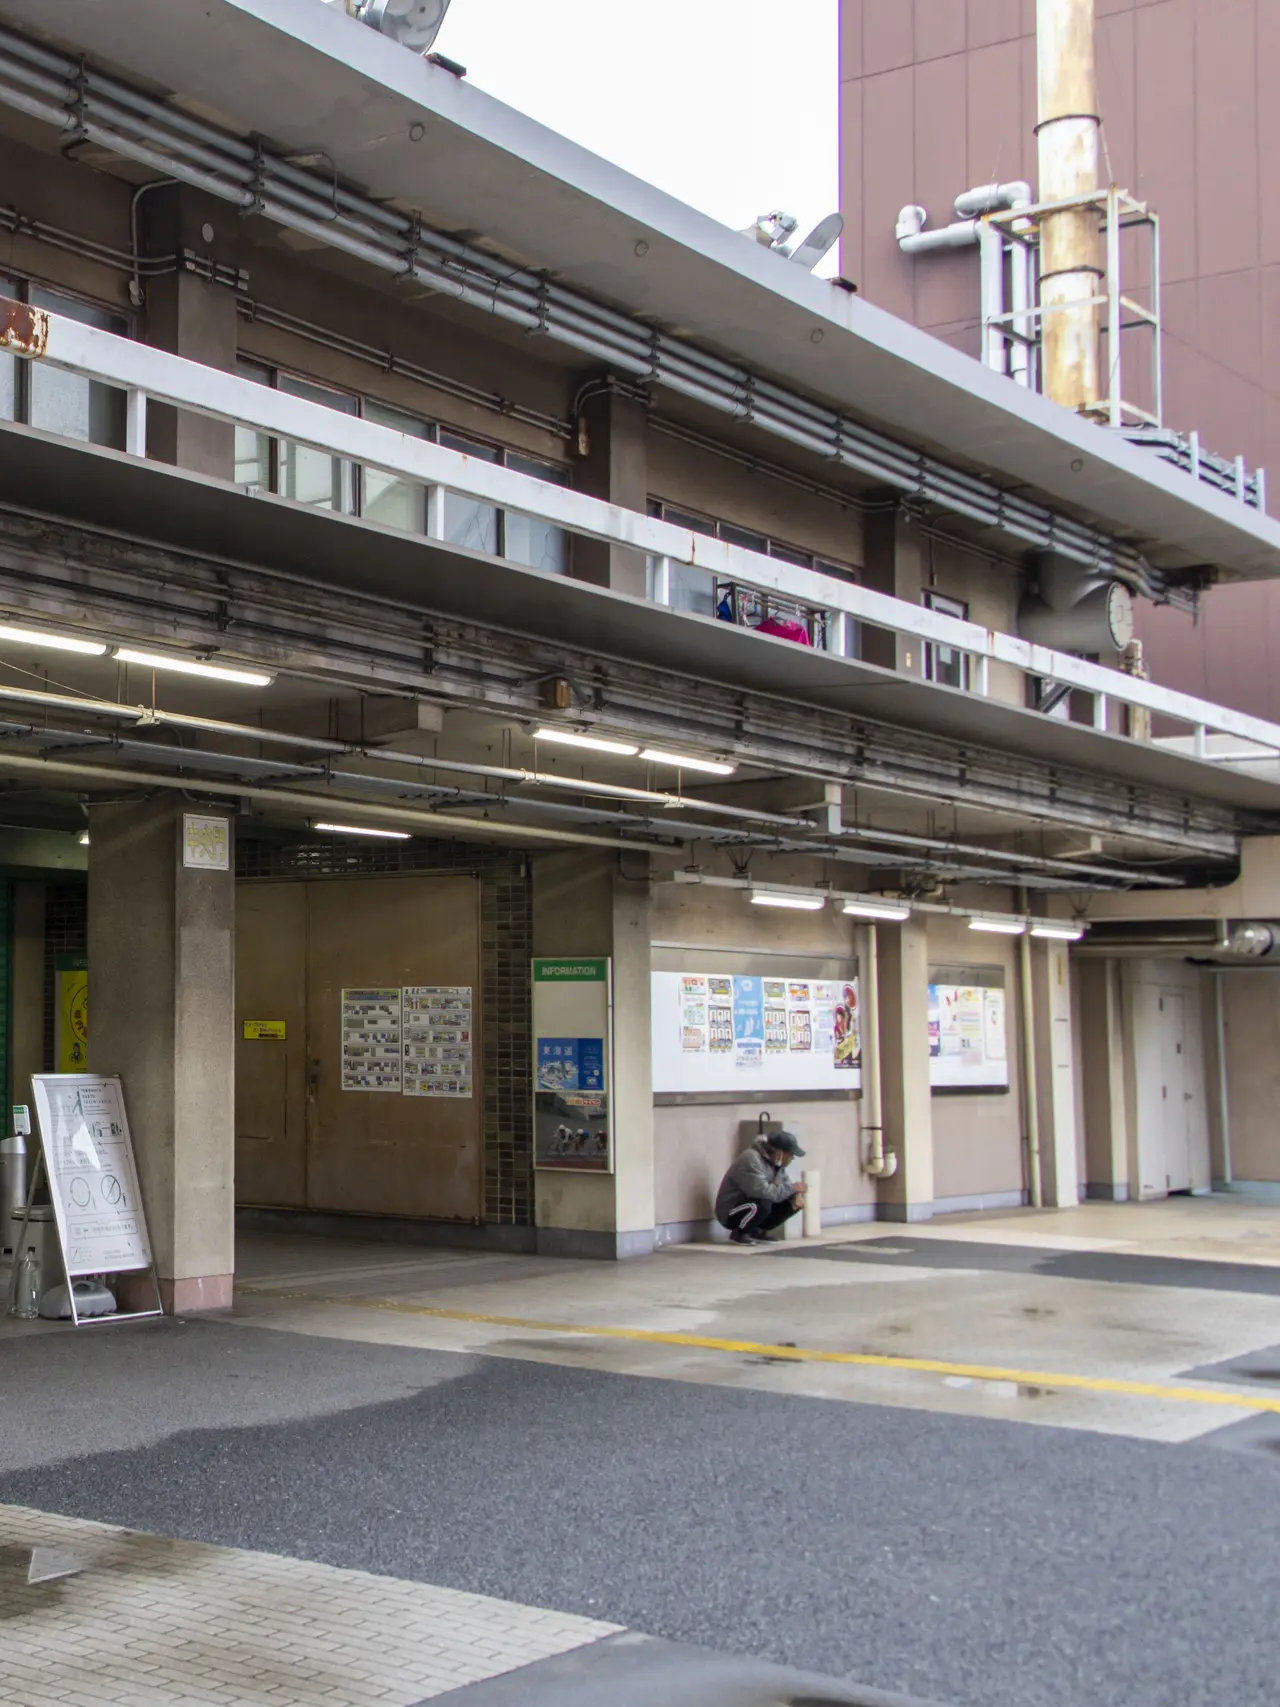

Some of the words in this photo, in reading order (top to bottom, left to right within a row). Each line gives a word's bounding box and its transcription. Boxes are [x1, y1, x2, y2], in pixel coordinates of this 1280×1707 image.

[186, 822, 226, 862] 中央門
[541, 966, 597, 976] INFORMATION
